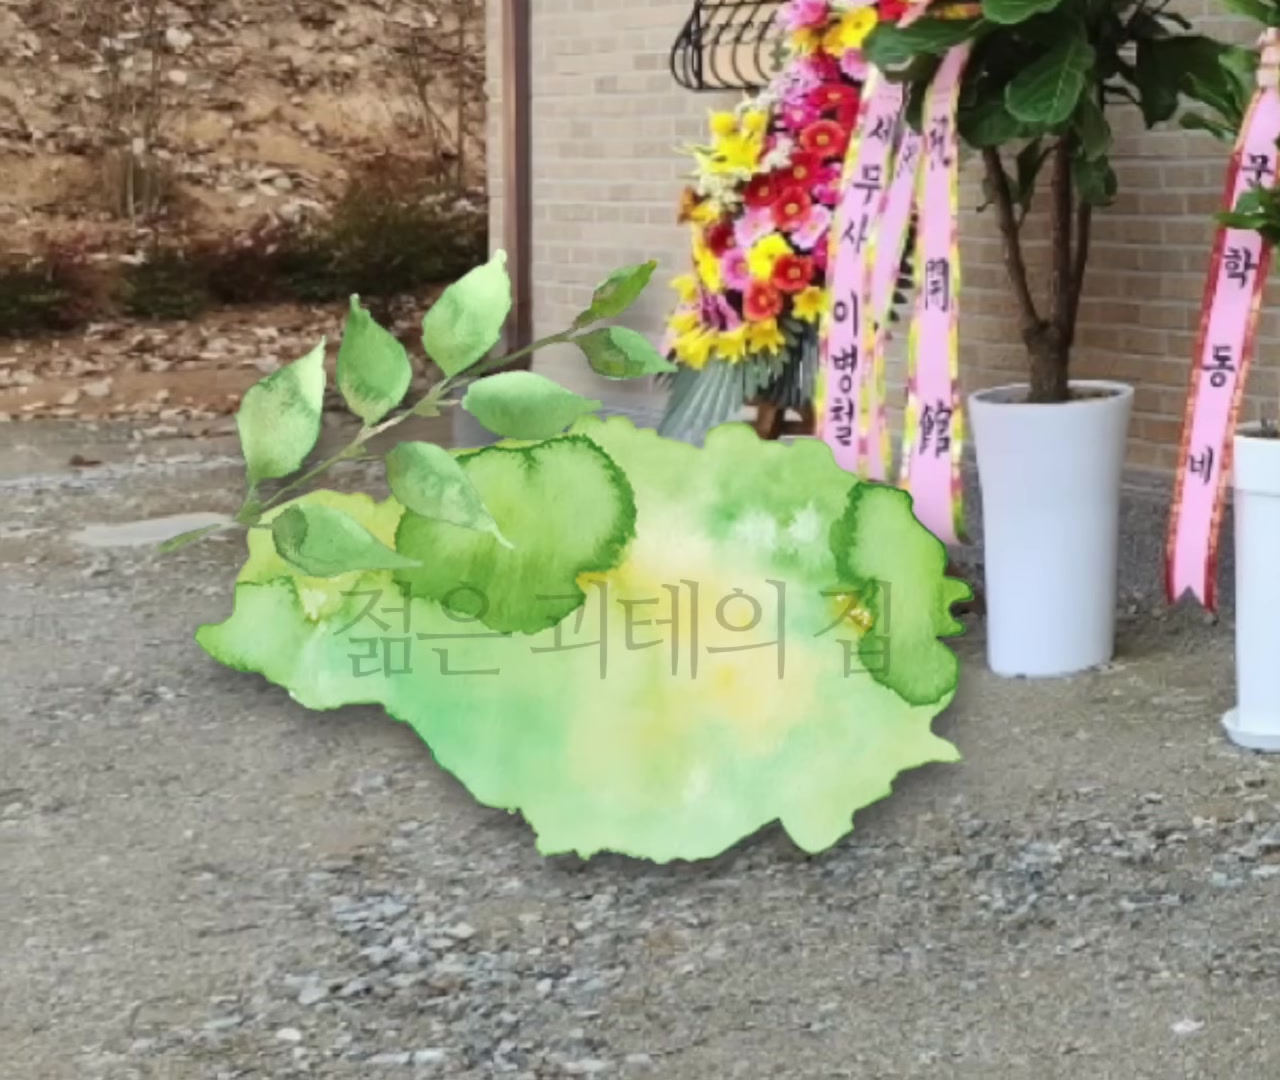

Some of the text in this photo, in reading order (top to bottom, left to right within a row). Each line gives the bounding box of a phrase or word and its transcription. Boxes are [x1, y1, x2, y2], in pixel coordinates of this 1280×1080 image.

[830, 114, 894, 447] 세무사 이병철
[1189, 154, 1275, 485] 문학동네
